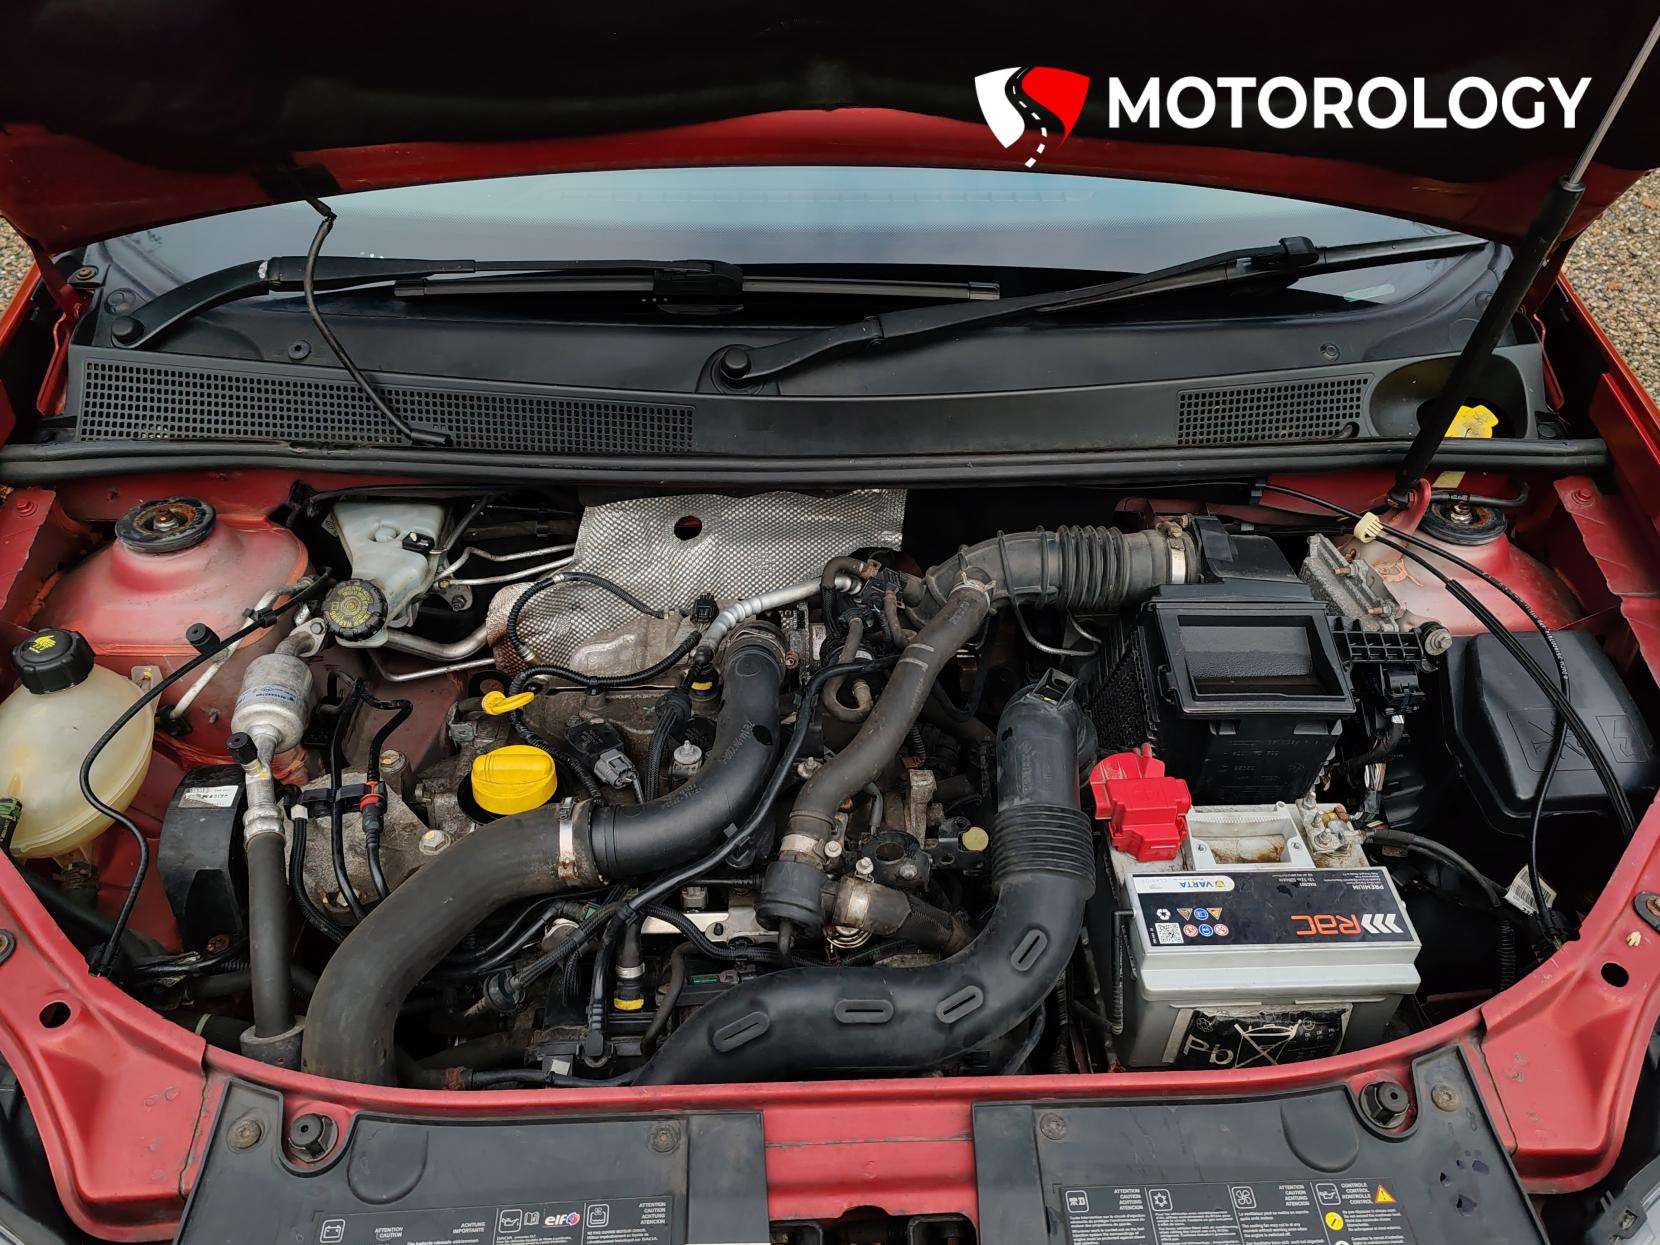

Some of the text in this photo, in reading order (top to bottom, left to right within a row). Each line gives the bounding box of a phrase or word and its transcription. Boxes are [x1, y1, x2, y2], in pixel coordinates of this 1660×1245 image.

[1179, 880, 1213, 889] VARTA
[1183, 1034, 1234, 1065] Pb
[544, 1212, 568, 1226] elf
